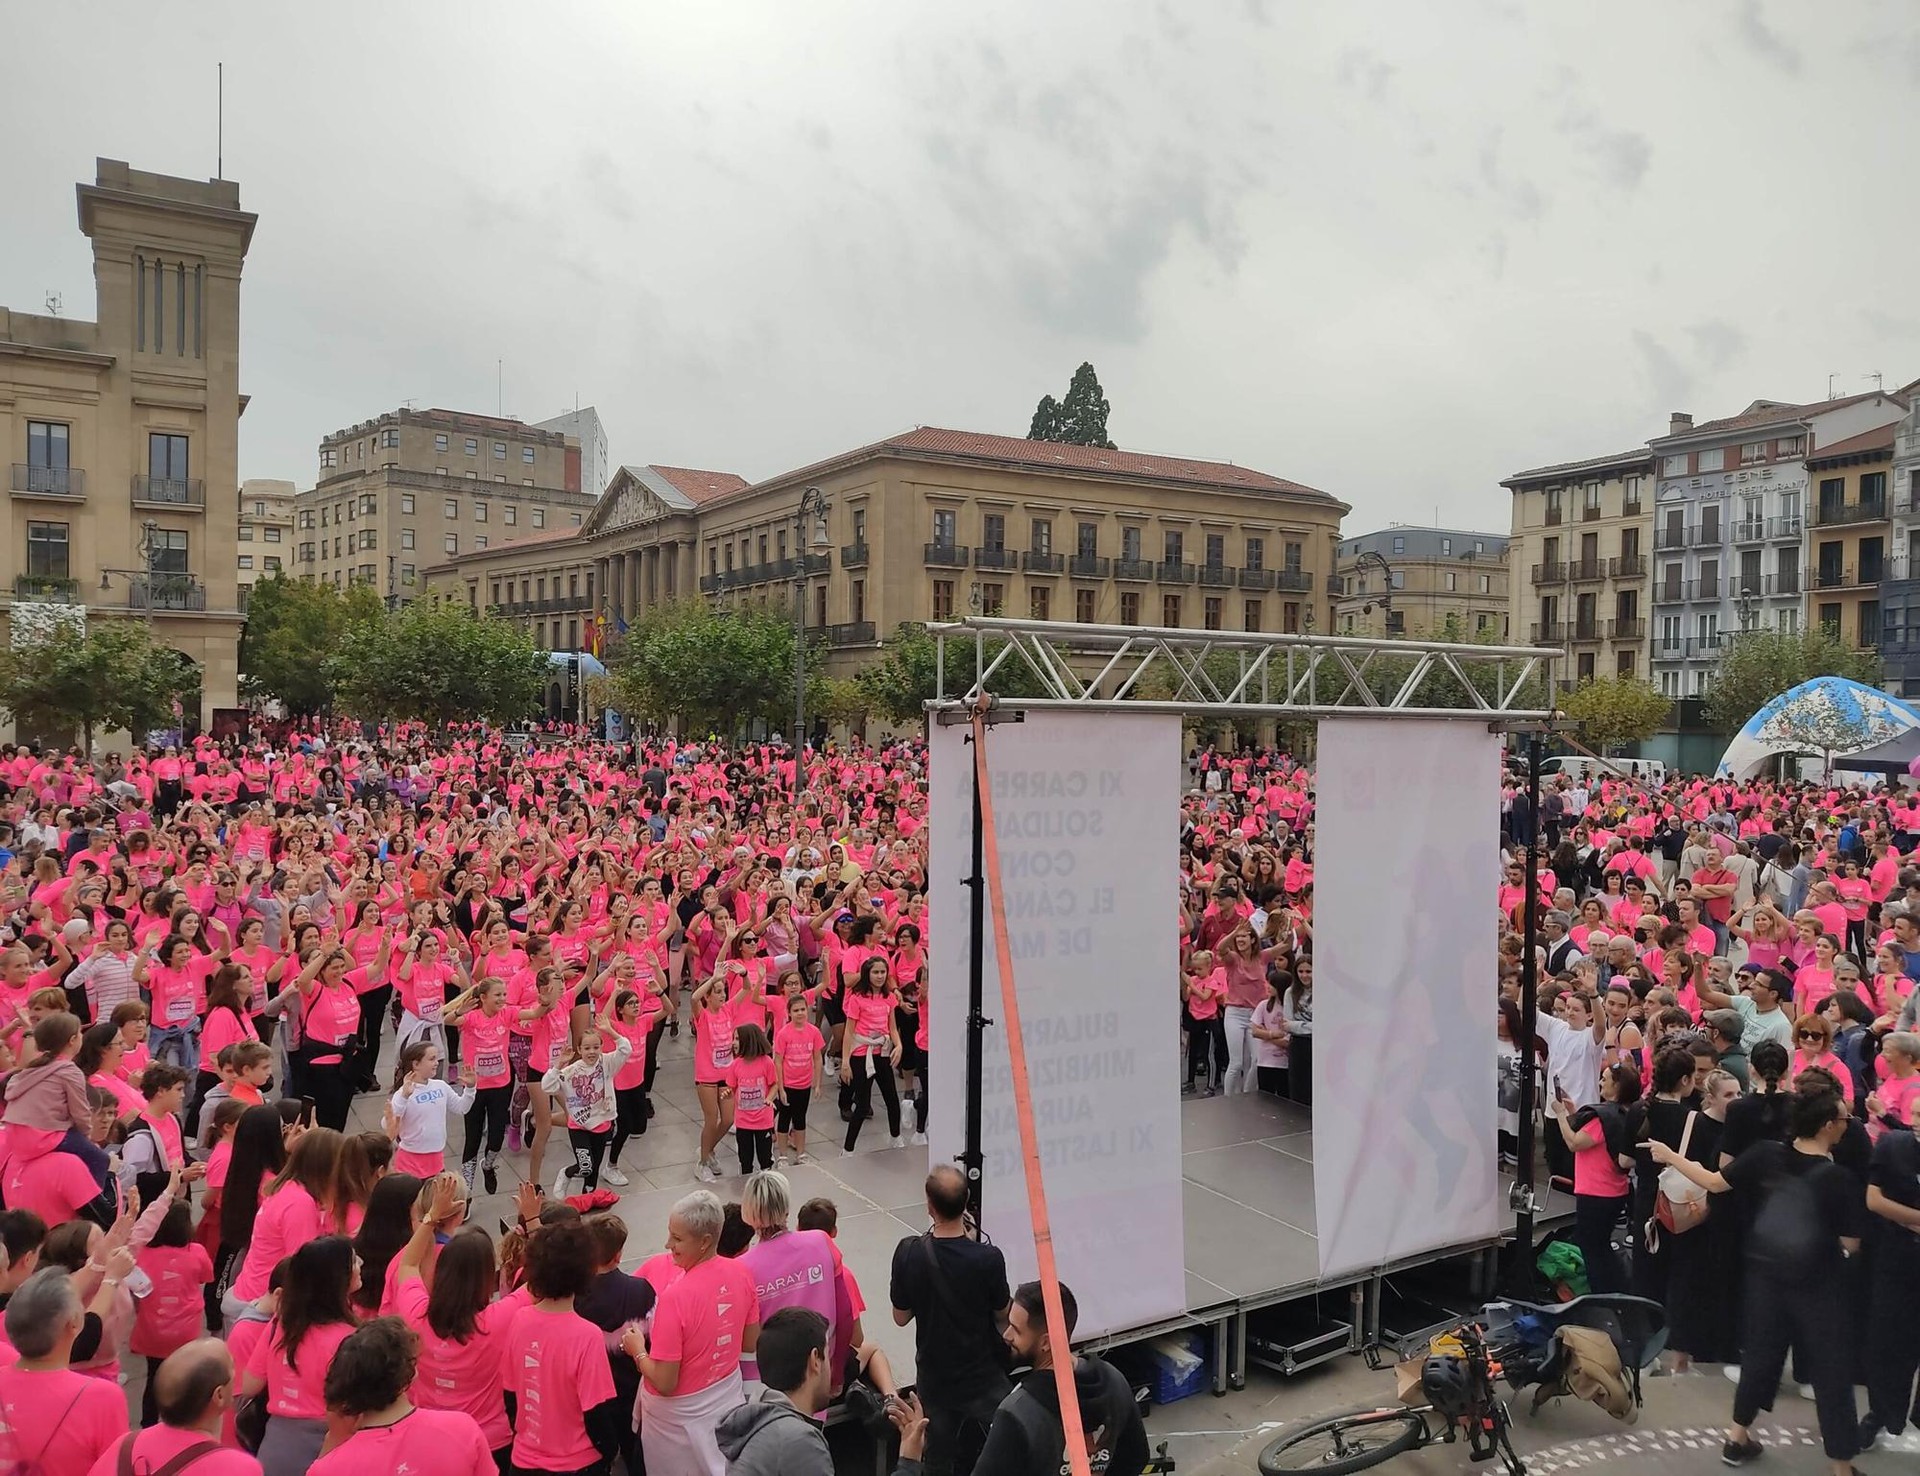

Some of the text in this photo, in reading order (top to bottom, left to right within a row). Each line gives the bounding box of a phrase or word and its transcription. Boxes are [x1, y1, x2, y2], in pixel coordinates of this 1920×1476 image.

[1689, 468, 1773, 490] EL CISNE
[1700, 489, 1731, 500] HOTEL
[577, 1112, 591, 1126] TRIP
[755, 1270, 803, 1296] SARAY
